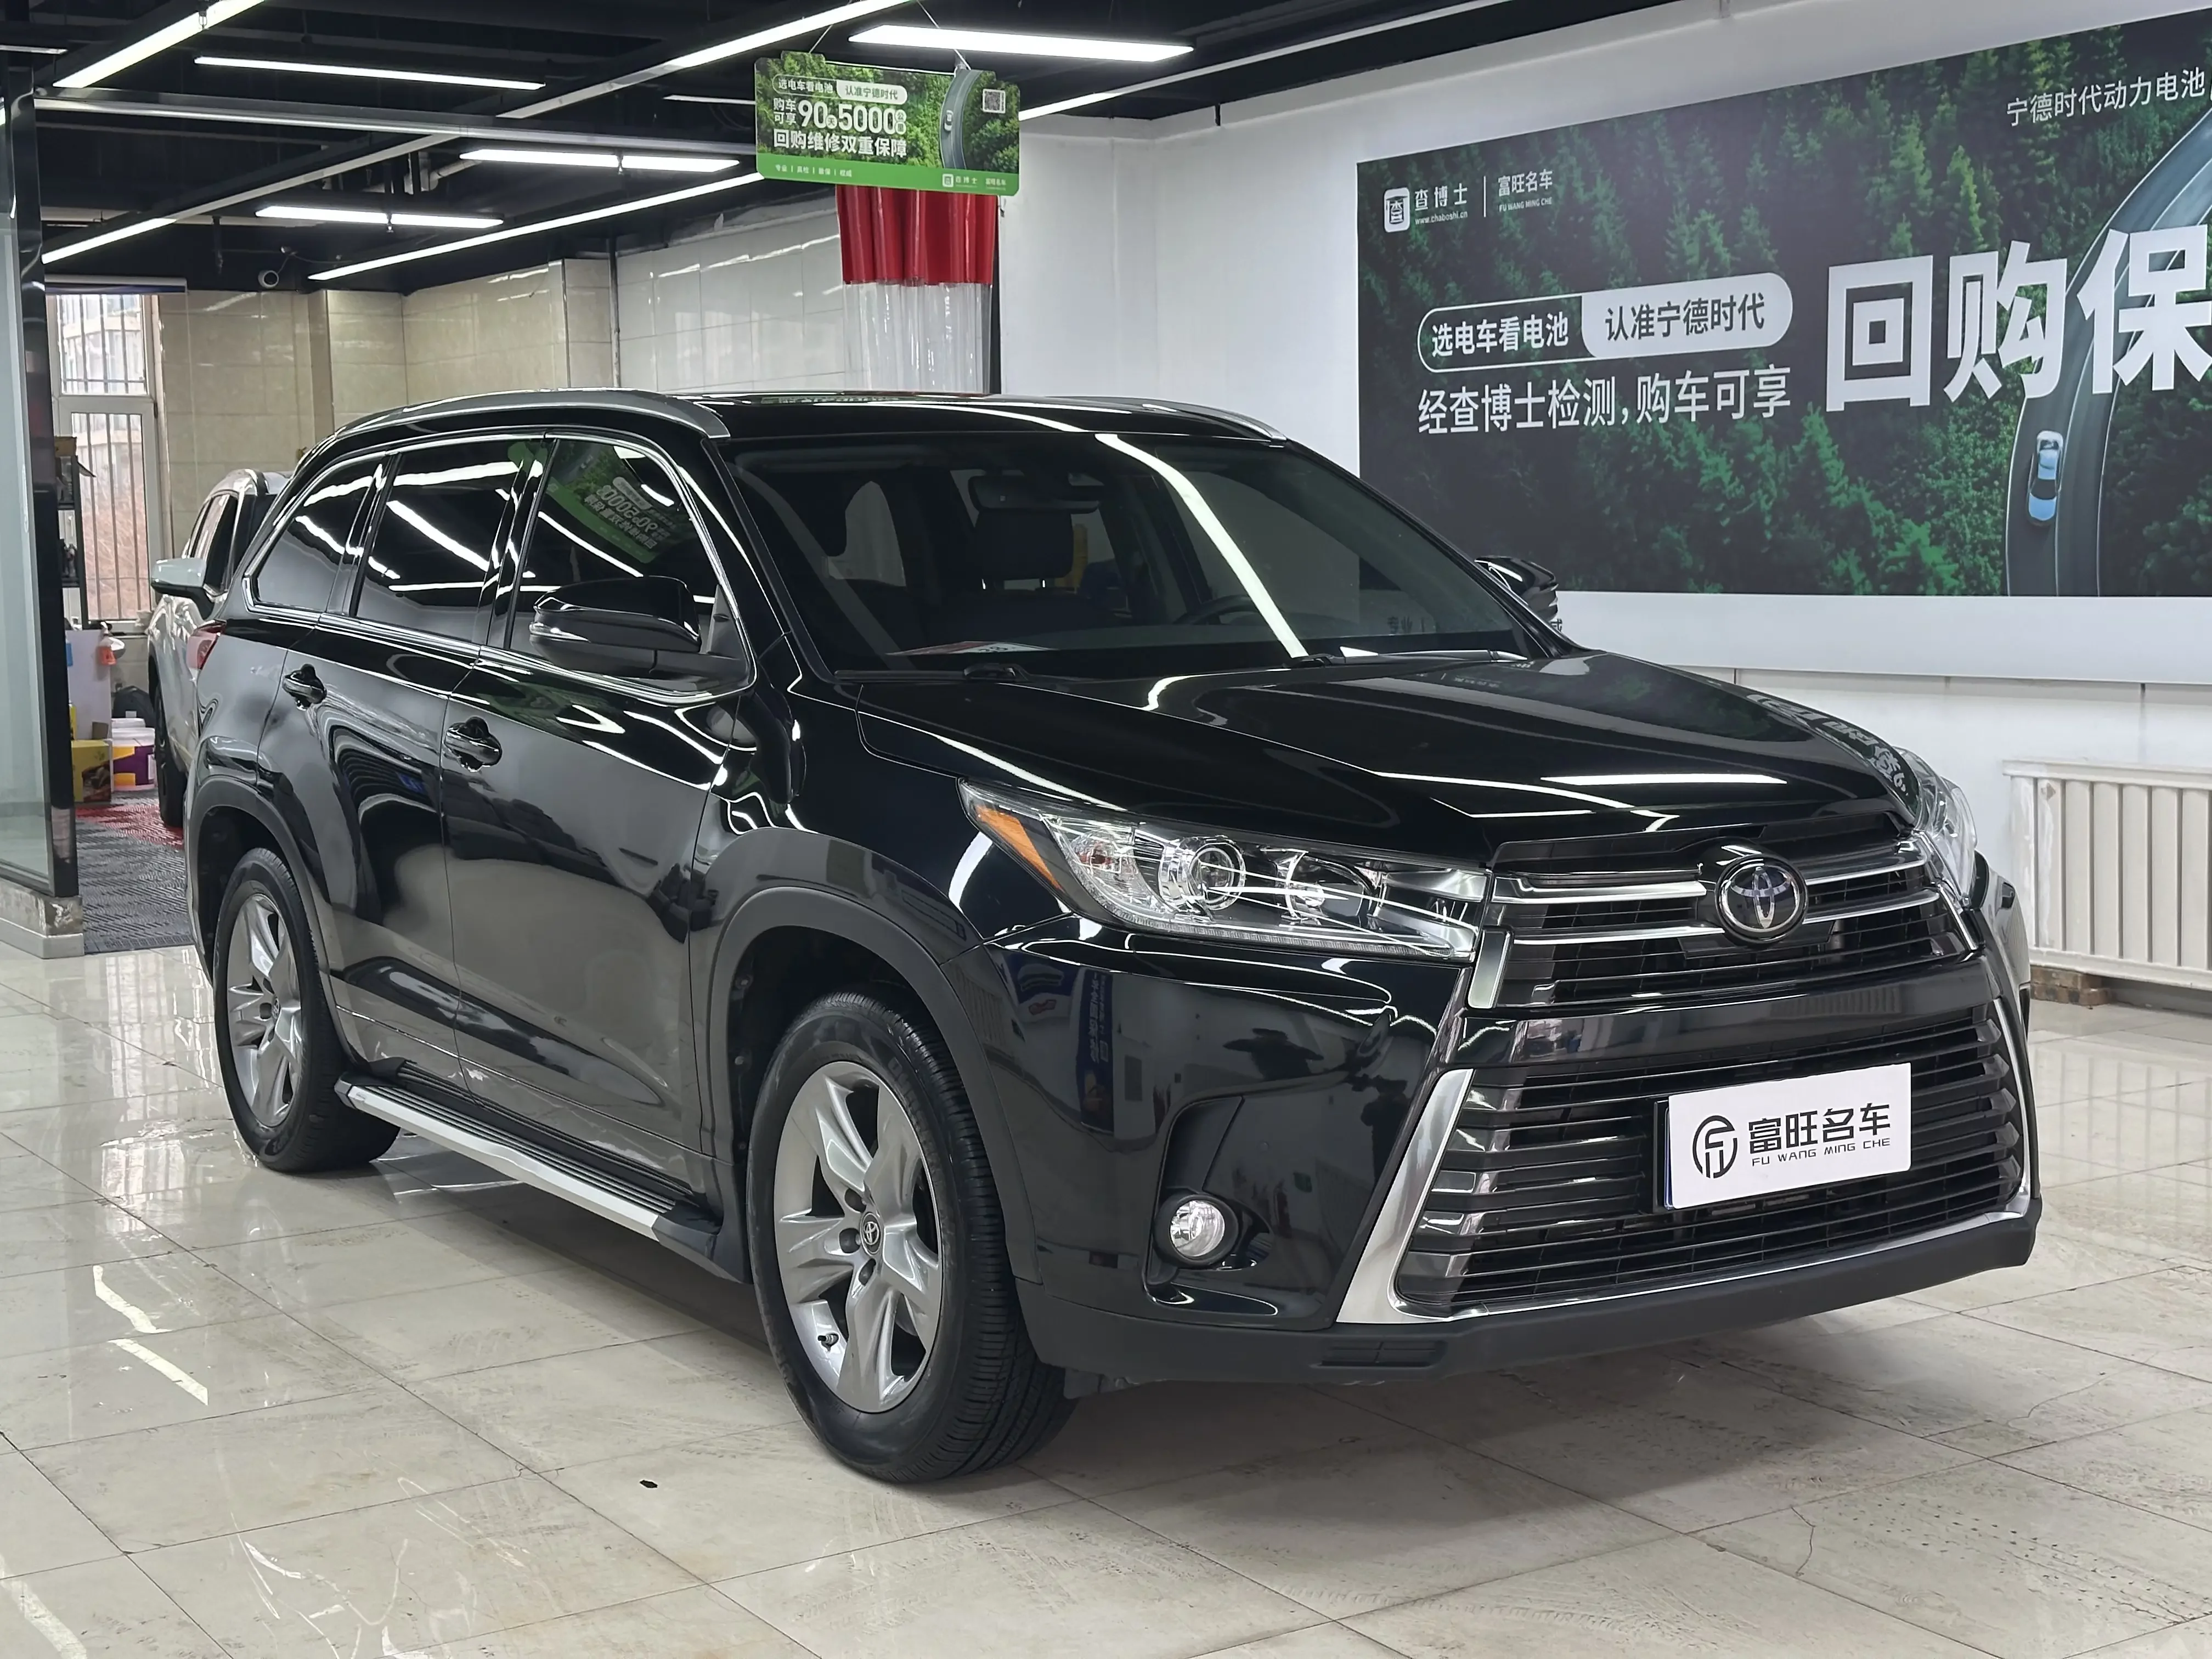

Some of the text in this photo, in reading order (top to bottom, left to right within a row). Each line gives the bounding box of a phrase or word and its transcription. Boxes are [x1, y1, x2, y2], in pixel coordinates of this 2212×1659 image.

[2006, 66, 2212, 127] 宁德时代动力电池
[773, 128, 906, 158] 回购维修双重保障
[1414, 182, 1468, 211] 查博士
[1498, 168, 1553, 198] 富旺名车
[1414, 210, 1468, 225] www.chaboshi.cn
[1431, 310, 1570, 358] 选电车看电池
[1605, 292, 1765, 342] 认准宁德时代
[1826, 224, 2212, 413] 回购保
[1748, 1102, 1891, 1154] 富旺名车
[1752, 1137, 1891, 1167] FU WANG MING CHE
